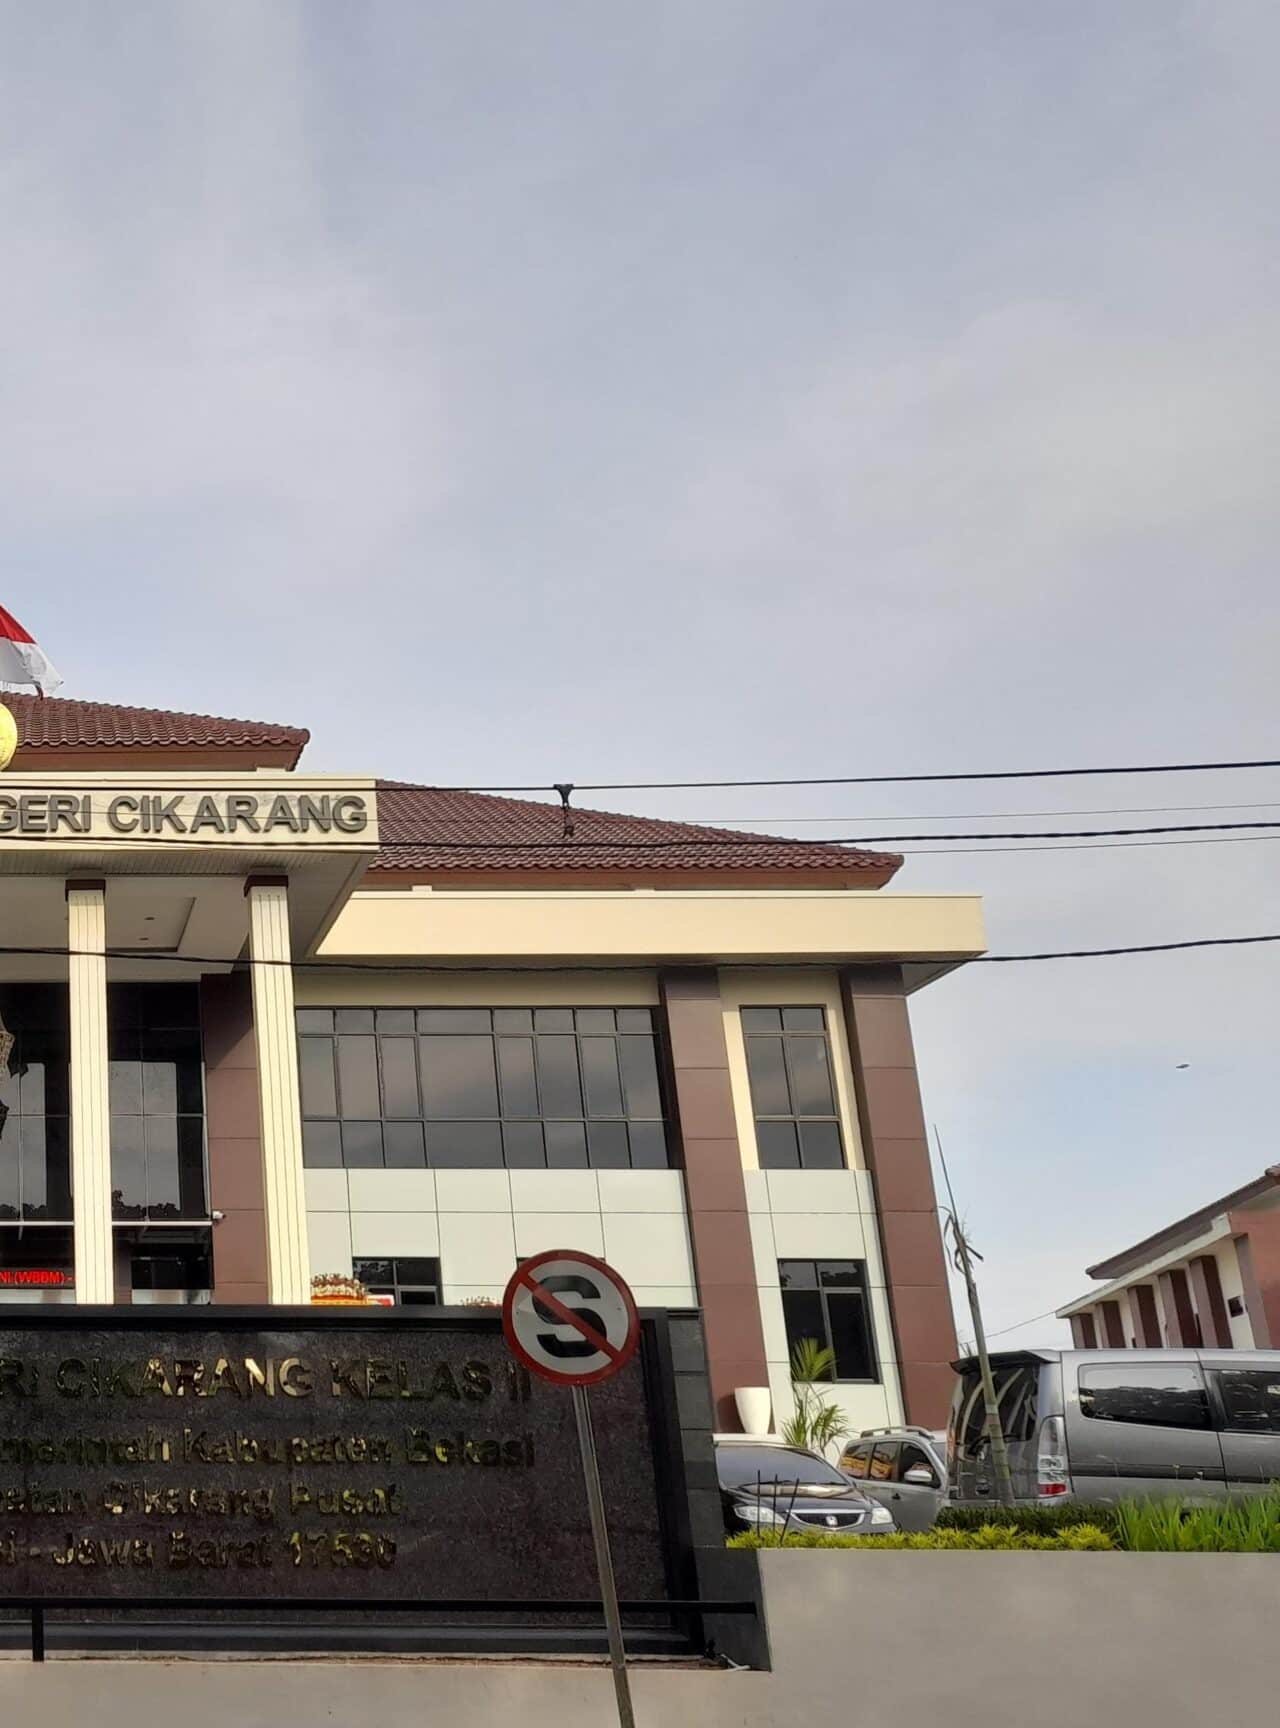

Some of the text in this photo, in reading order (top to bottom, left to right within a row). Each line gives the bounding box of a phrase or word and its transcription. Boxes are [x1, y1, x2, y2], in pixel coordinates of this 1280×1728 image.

[107, 795, 368, 833] CIKARANG
[55, 1357, 313, 1397] CIKARANG
[329, 1359, 492, 1400] KELAS
[184, 1429, 393, 1468] Kabupaten
[406, 1430, 537, 1468] Bekasi
[103, 1481, 275, 1521] Cikarang
[289, 1482, 403, 1517] Pusat
[51, 1532, 154, 1568] Jawa
[168, 1531, 274, 1569] Barat
[289, 1532, 398, 1570] 17530
